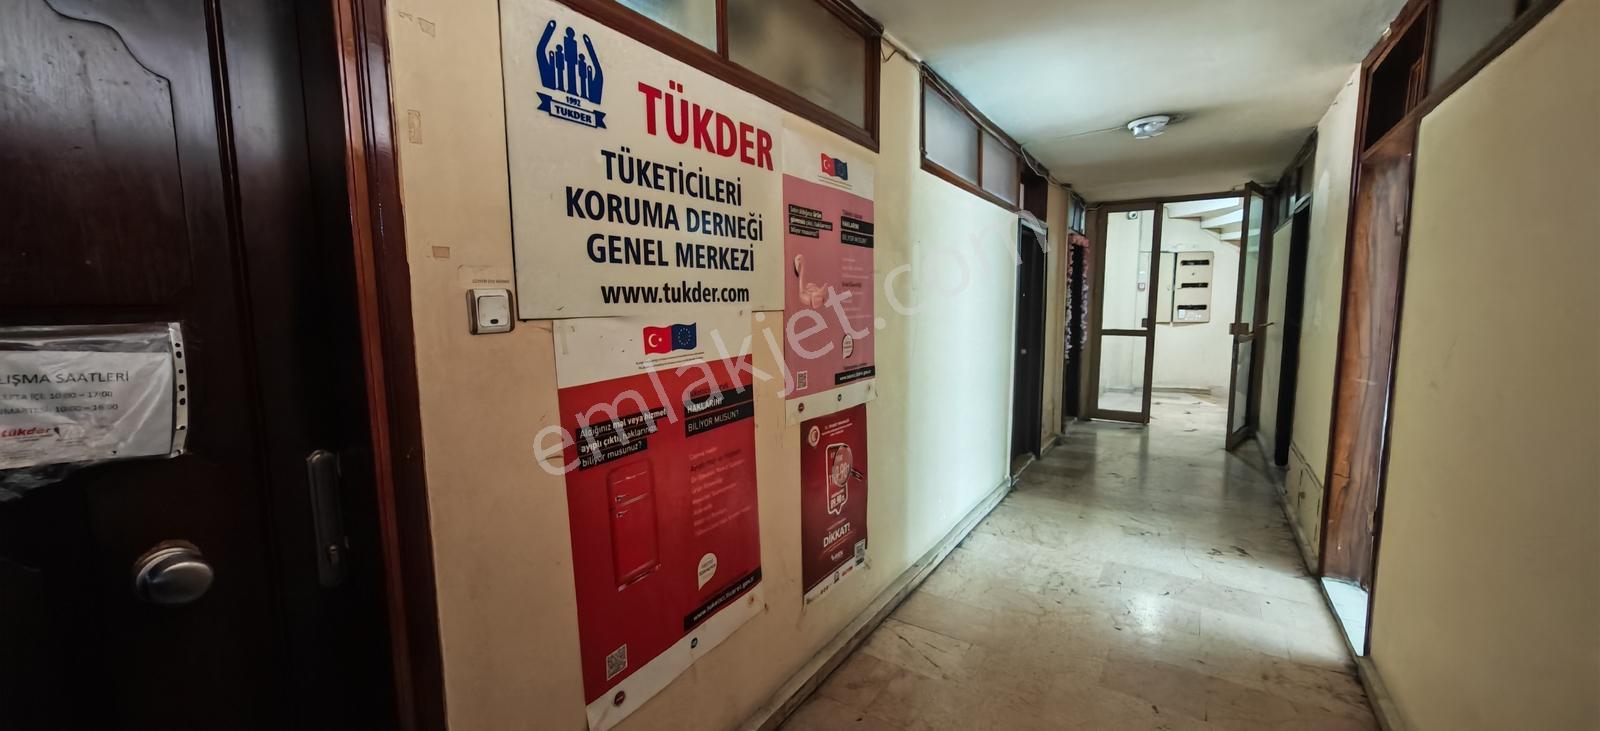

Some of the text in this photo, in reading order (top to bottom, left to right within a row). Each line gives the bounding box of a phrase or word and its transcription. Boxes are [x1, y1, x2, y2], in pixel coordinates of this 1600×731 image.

[566, 96, 581, 107] 1992
[554, 105, 592, 123] TUKDER
[638, 80, 774, 171] TÜKDER
[601, 146, 742, 206] TÜKETİCİLERİ
[565, 186, 763, 241] KORUMA DERNEĞİ
[587, 233, 754, 271] GENEL MERKEZİ
[601, 280, 750, 304] www.tukder.com
[56, 370, 129, 384] SAATLERİ
[627, 415, 643, 426] veya
[607, 441, 642, 459] musunuz?
